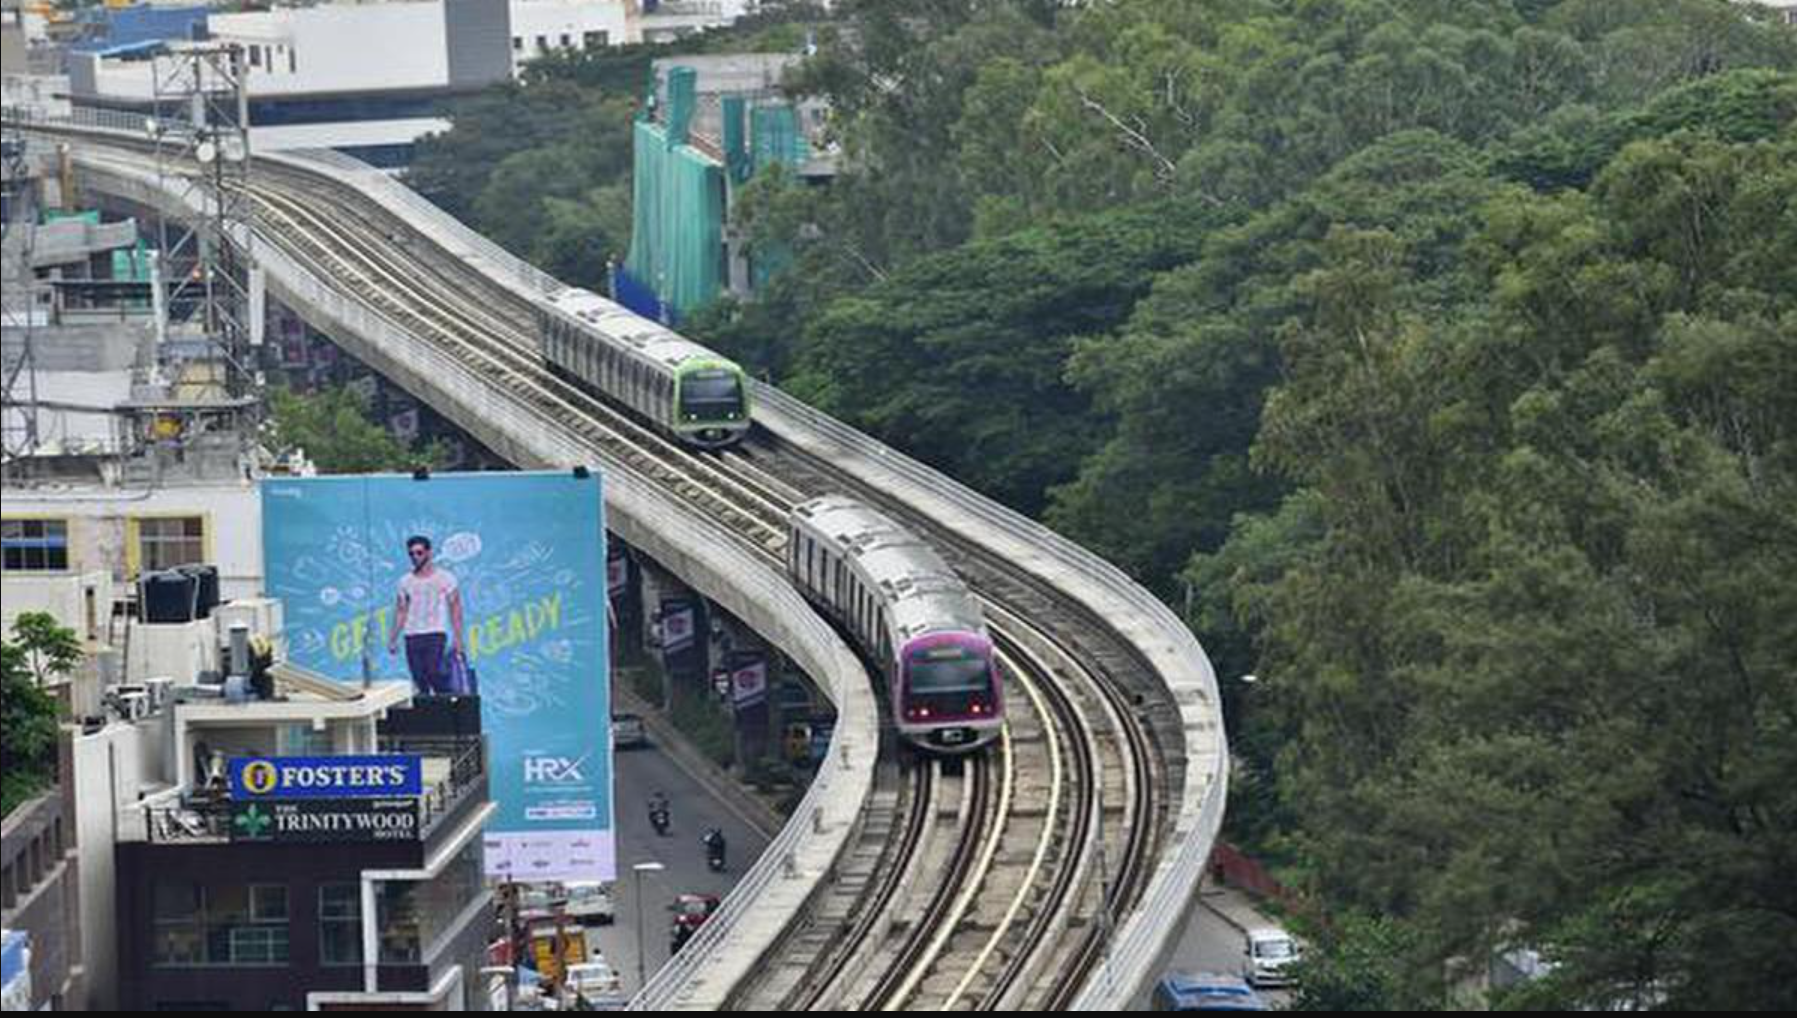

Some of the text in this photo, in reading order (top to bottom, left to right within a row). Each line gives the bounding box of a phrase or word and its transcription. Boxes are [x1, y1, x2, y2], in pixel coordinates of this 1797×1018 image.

[329, 590, 563, 662] GET READY
[281, 766, 406, 788] FOSTER'S
[524, 756, 587, 781] HRX
[275, 812, 415, 830] TRINITYWOOD
